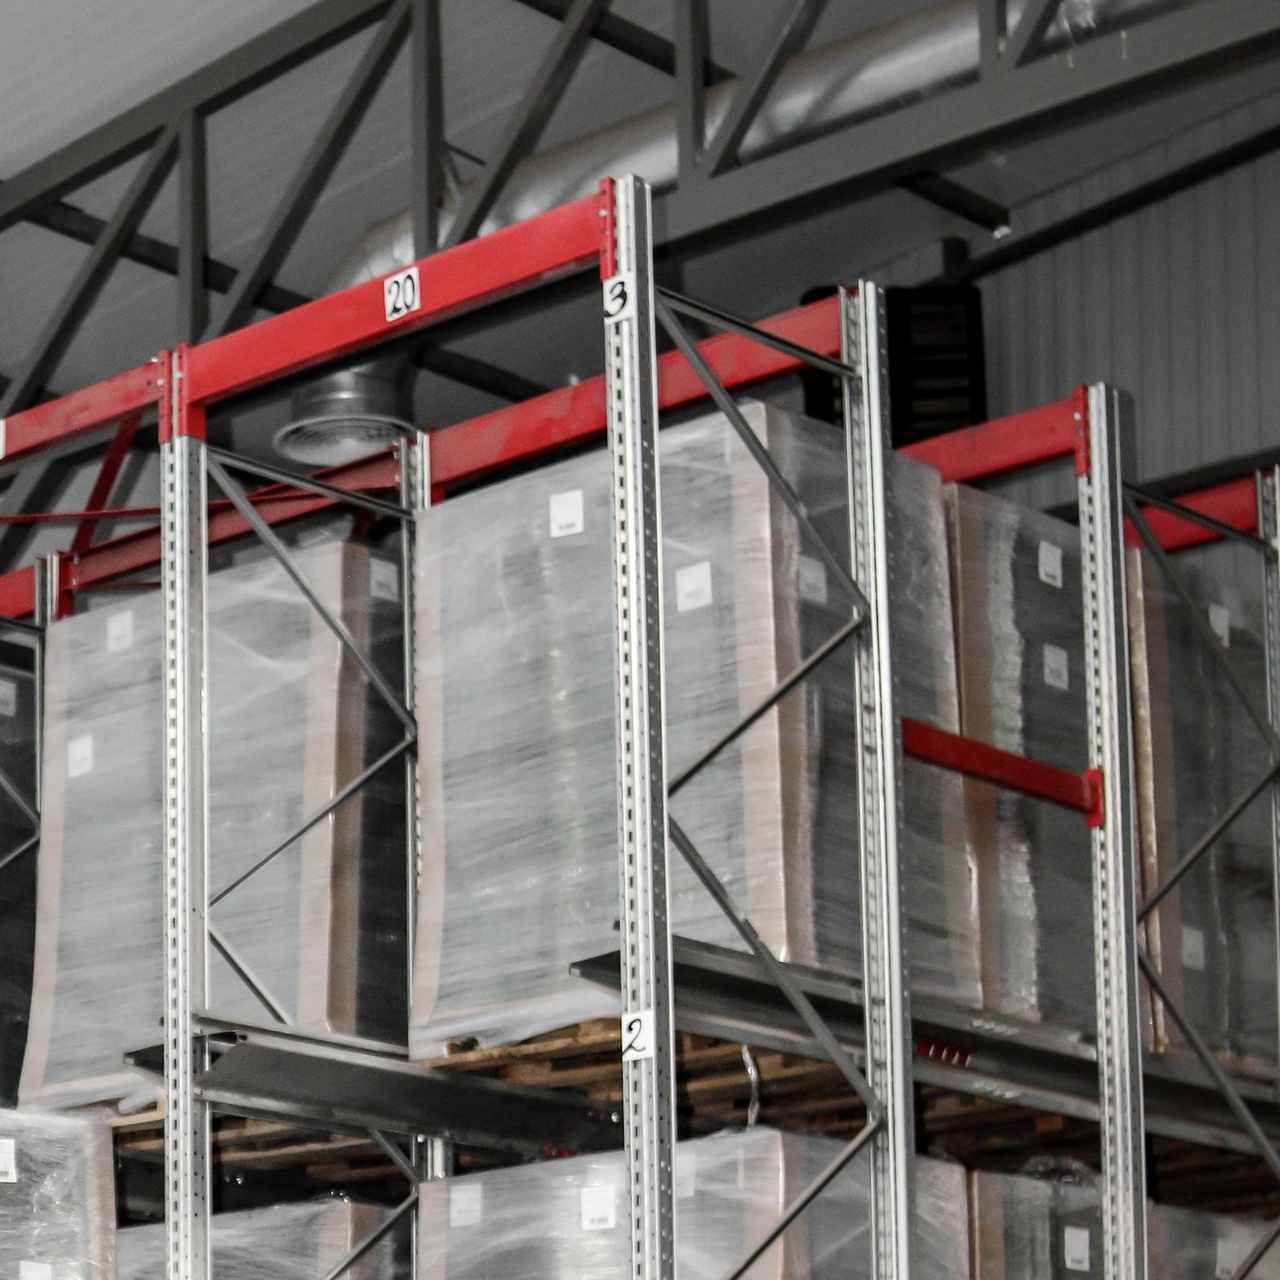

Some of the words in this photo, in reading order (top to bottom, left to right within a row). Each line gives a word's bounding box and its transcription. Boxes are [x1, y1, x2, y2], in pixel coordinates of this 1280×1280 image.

[387, 273, 415, 317] 20
[604, 281, 627, 318] 3
[621, 1018, 646, 1057] 2
